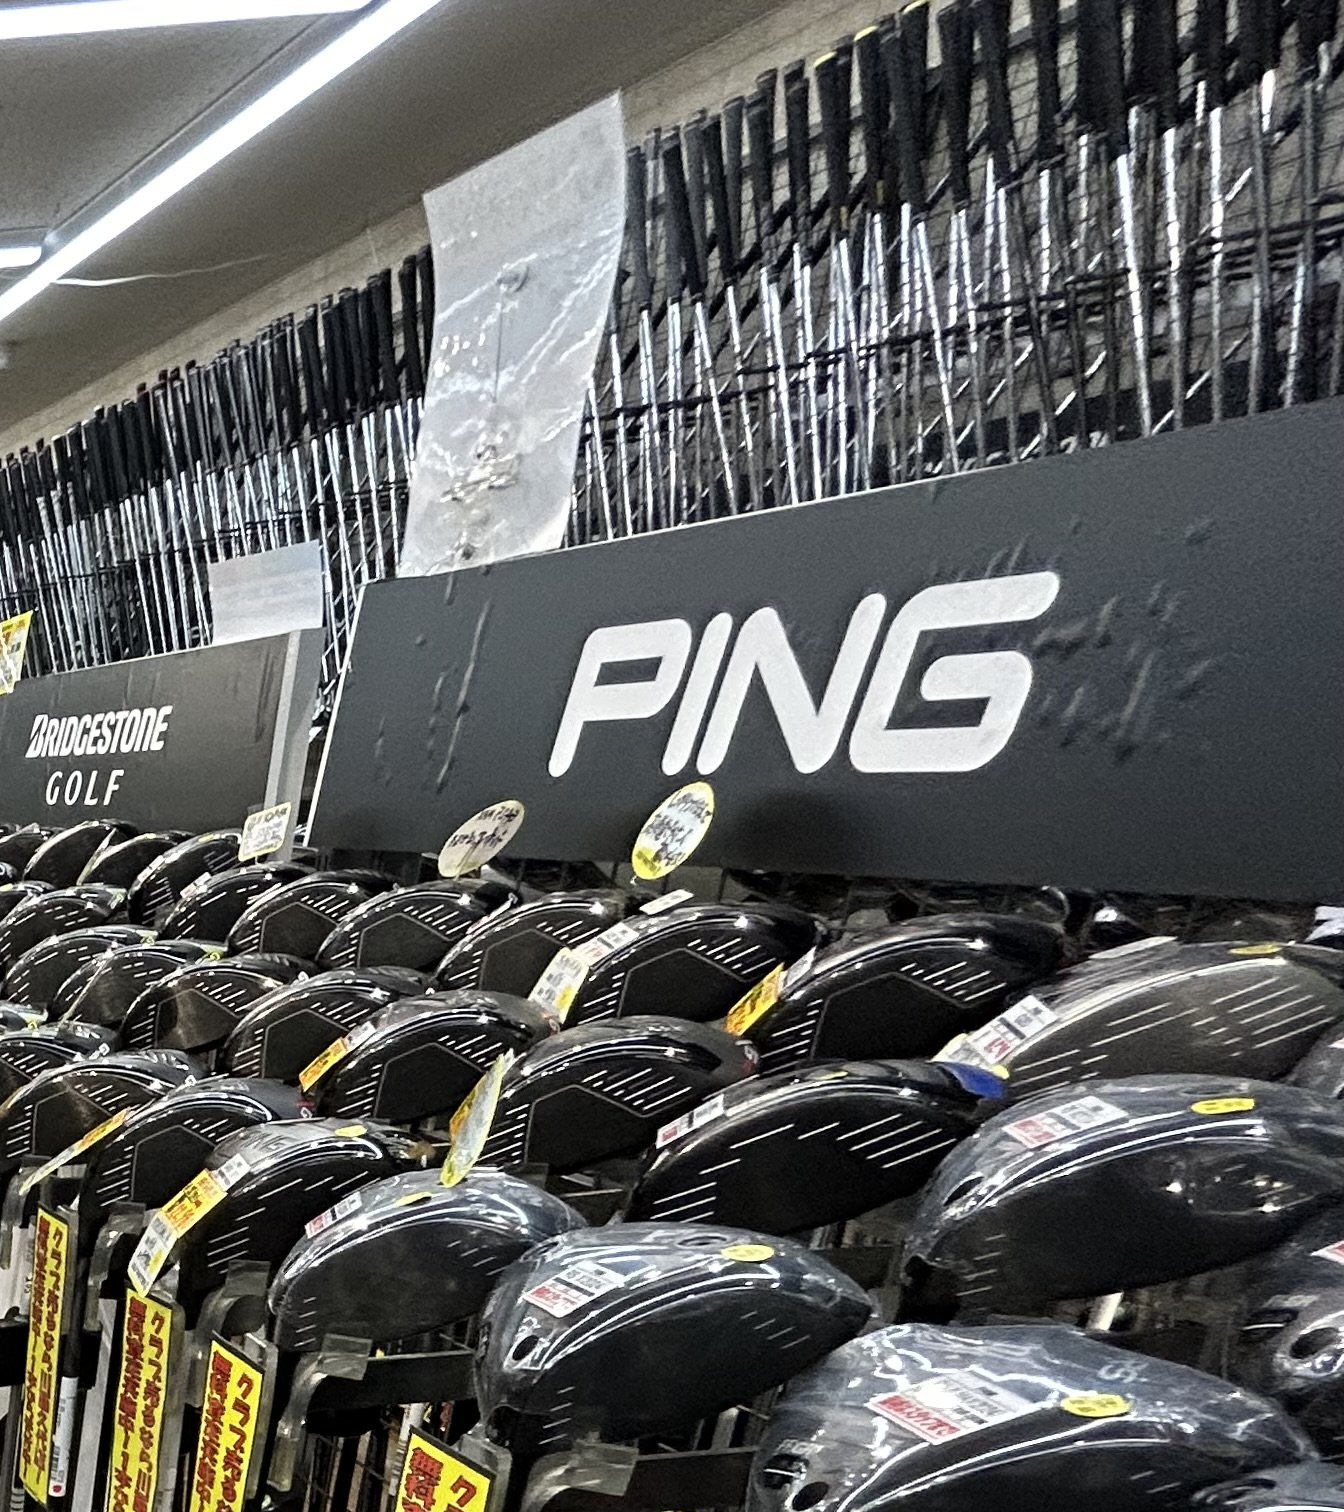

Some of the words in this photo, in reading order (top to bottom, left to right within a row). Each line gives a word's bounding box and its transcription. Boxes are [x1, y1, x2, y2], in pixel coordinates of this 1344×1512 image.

[548, 570, 1061, 779] PING
[25, 704, 173, 760] BRIDGESTONE
[46, 768, 125, 807] GOLF
